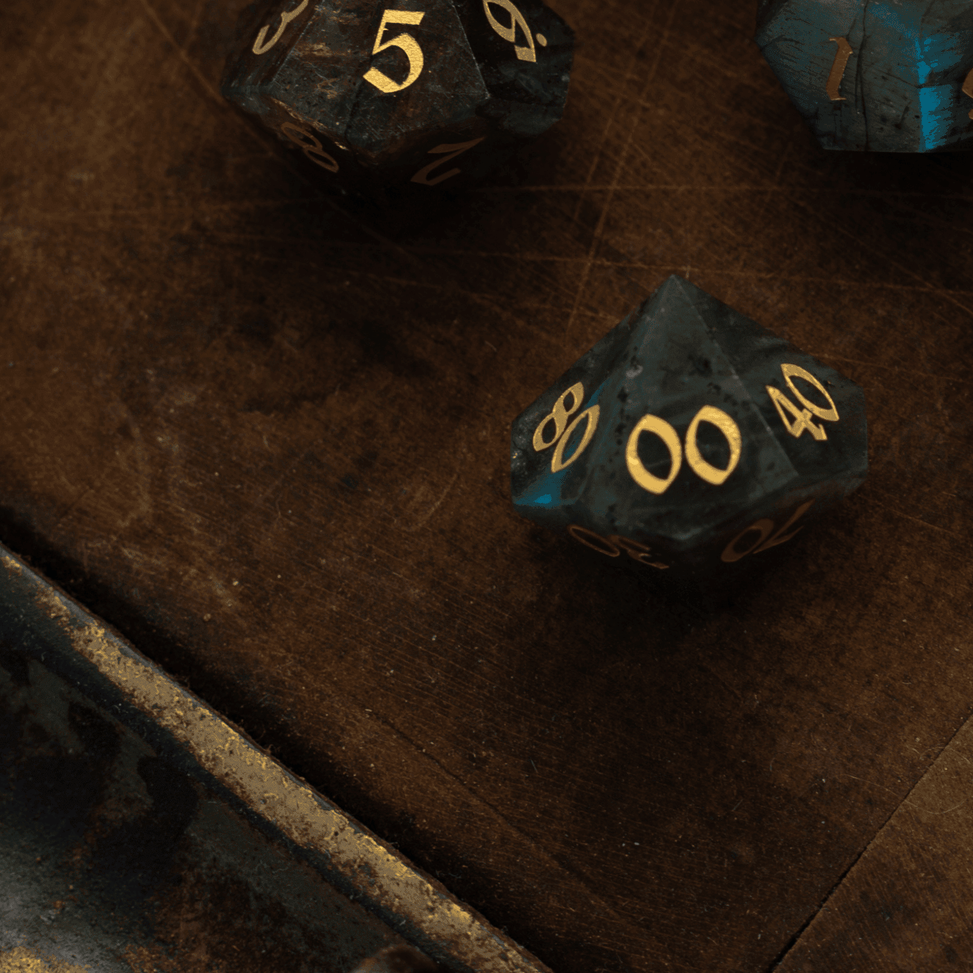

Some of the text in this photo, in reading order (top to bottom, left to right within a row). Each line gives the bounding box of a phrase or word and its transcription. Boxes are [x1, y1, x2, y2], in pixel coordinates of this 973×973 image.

[362, 8, 426, 93] 5
[826, 36, 853, 102] 1
[280, 121, 340, 174] 8
[410, 135, 487, 187] 2
[532, 381, 600, 475] 80
[765, 362, 840, 442] 40
[625, 403, 743, 495] 00
